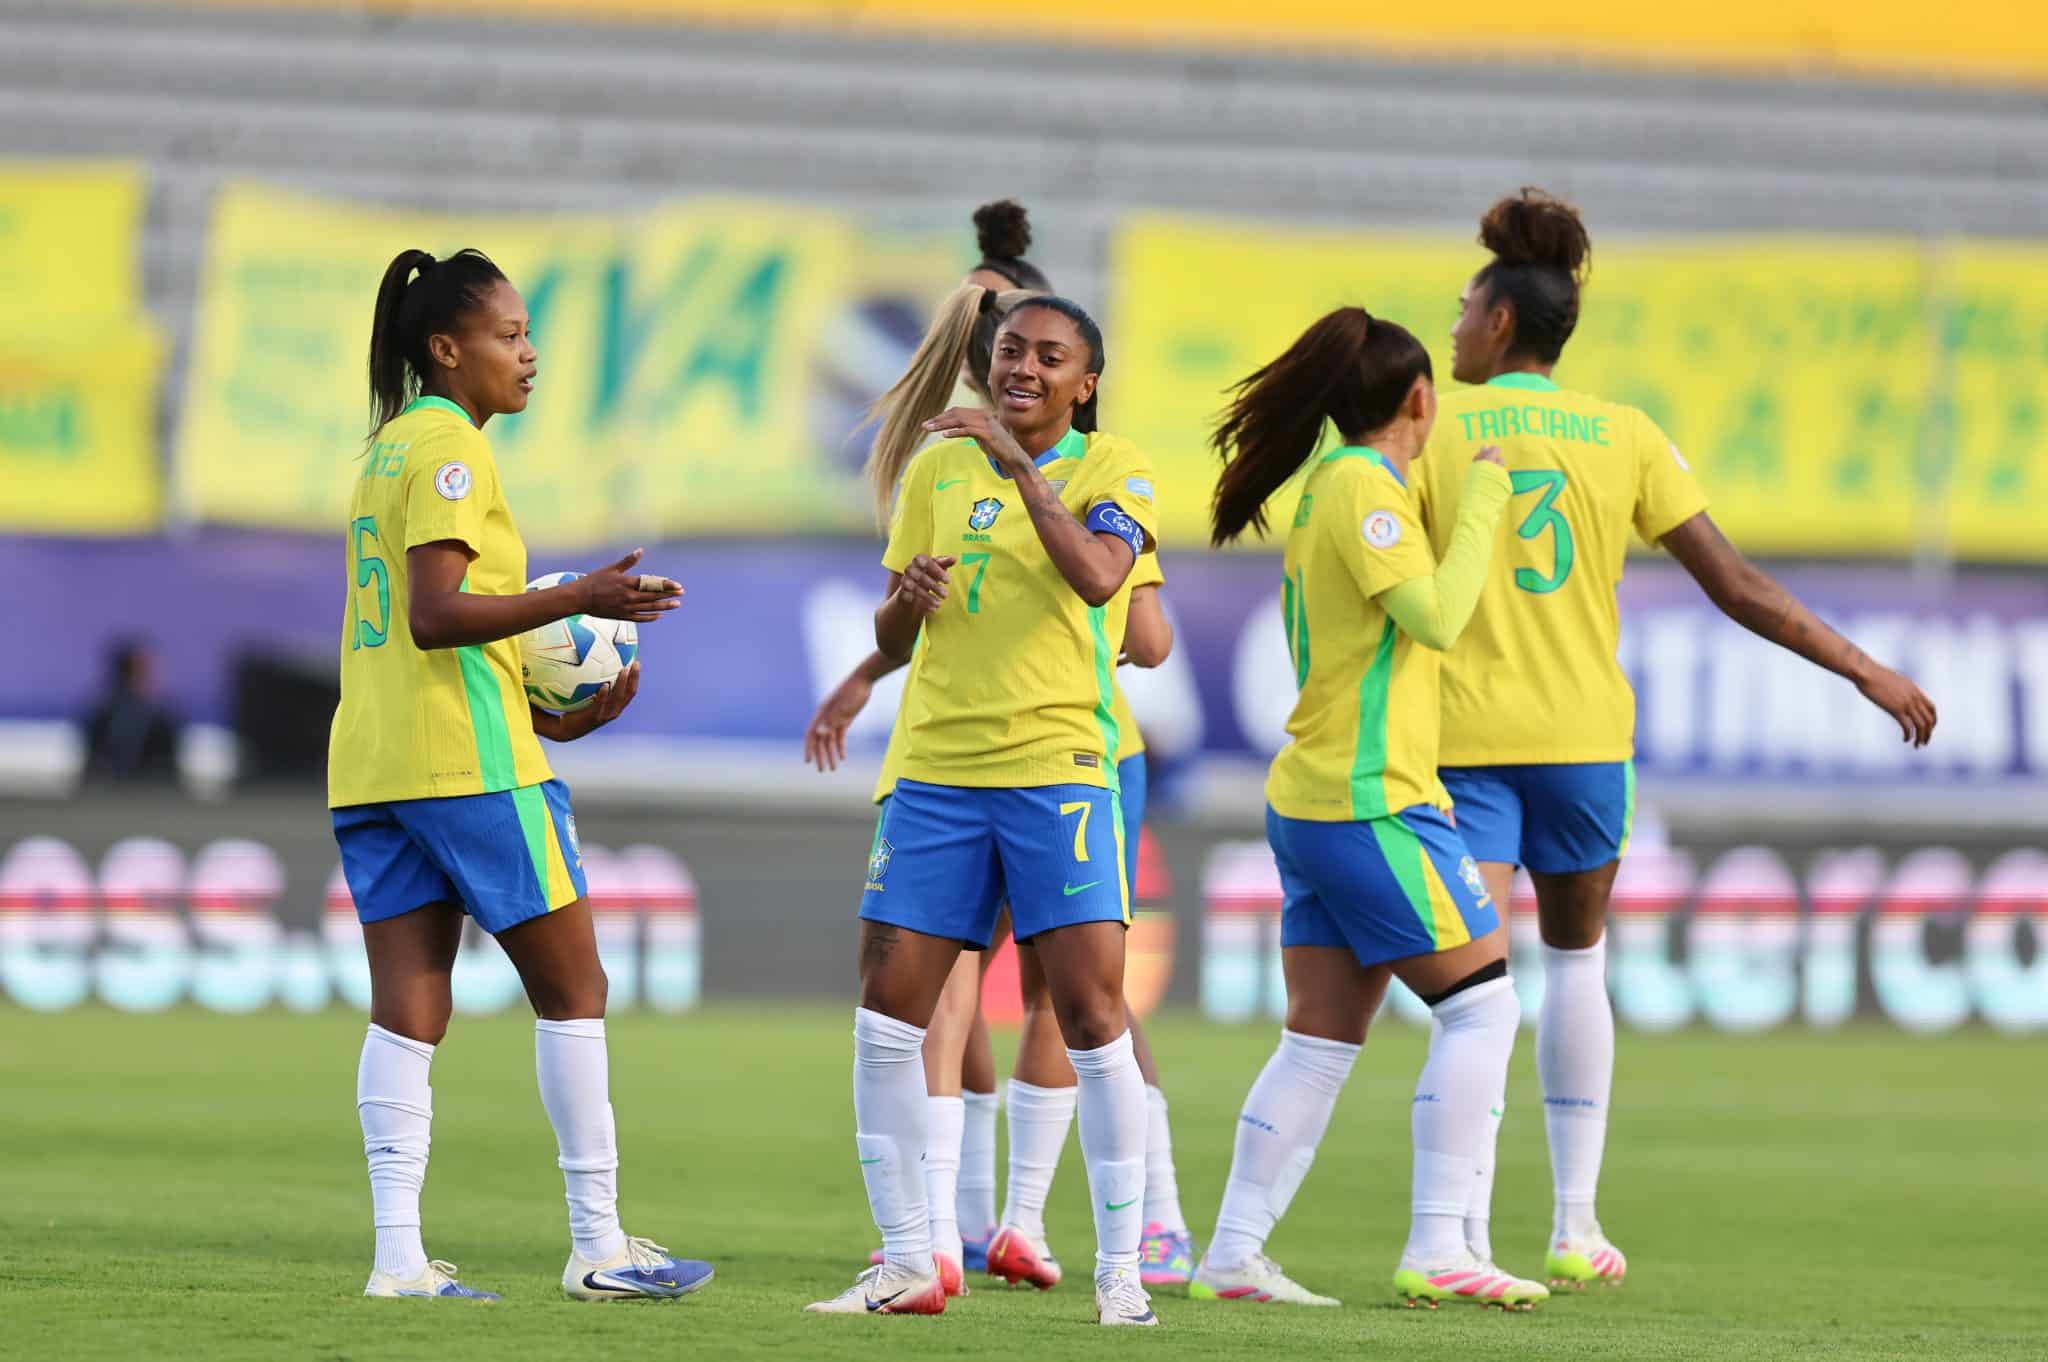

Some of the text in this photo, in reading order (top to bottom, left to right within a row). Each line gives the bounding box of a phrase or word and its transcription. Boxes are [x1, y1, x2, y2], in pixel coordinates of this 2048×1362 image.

[1456, 405, 1612, 447] TARCIANE
[962, 533, 993, 543] BRASIL
[1508, 469, 1575, 594] 3
[961, 552, 992, 614] 7
[1059, 801, 1092, 862] 7
